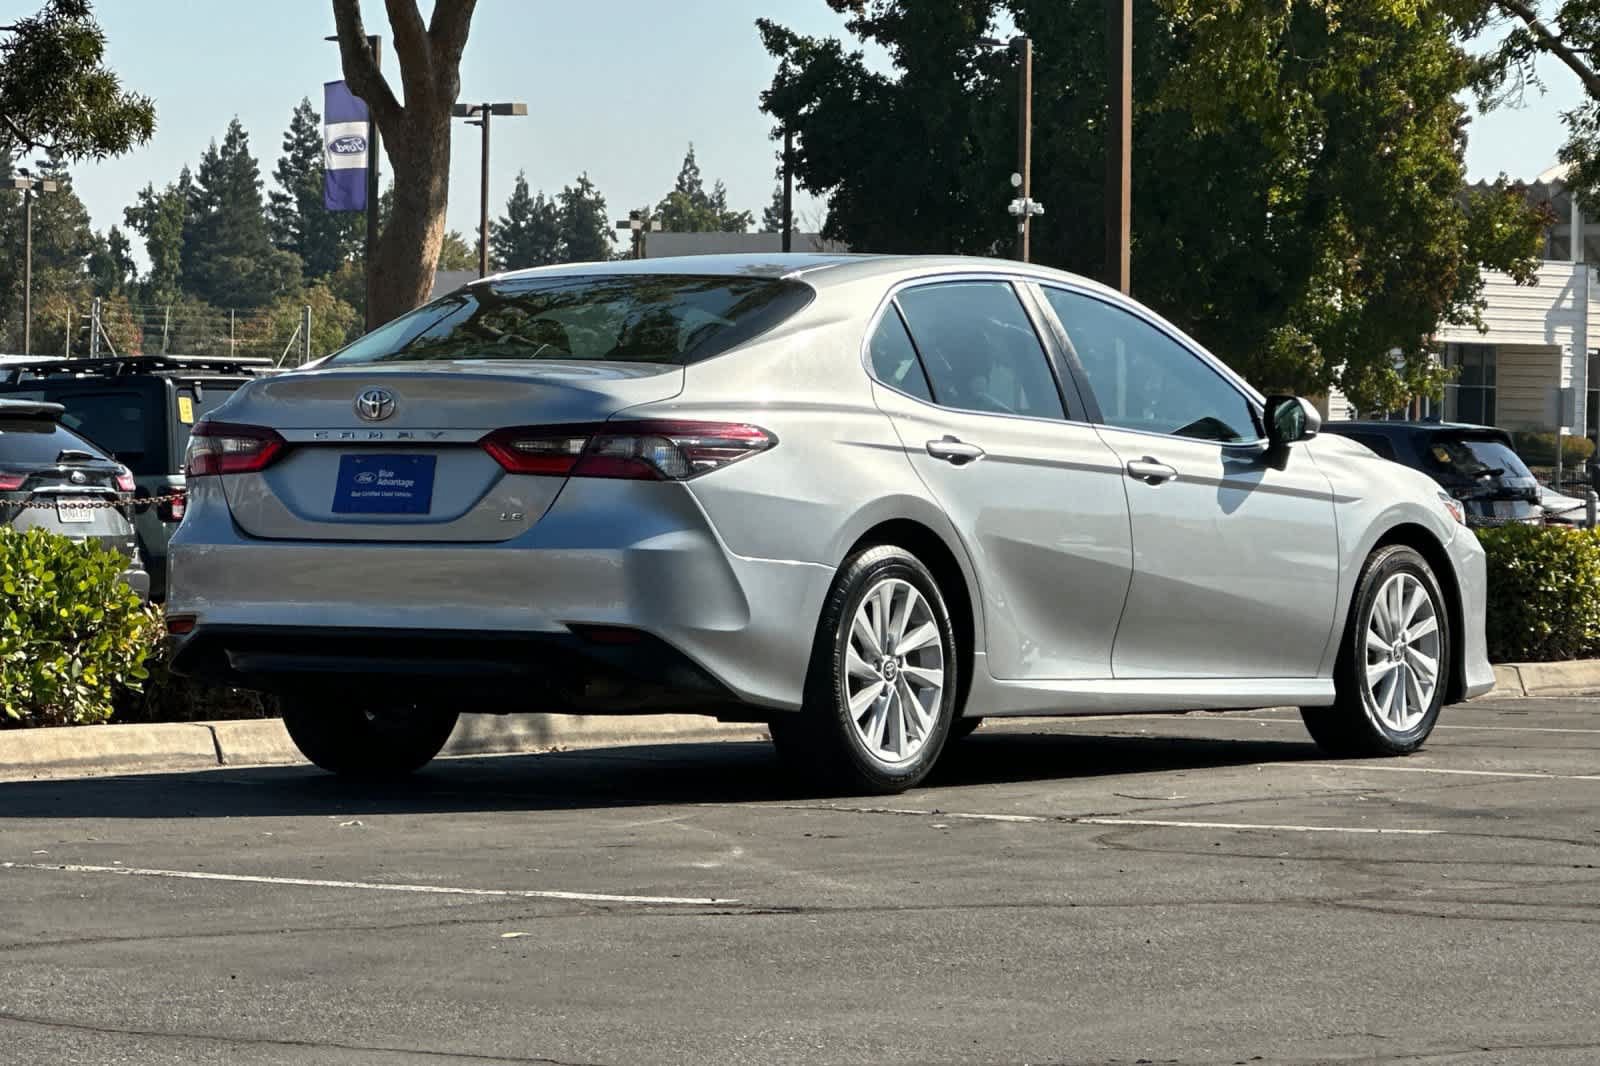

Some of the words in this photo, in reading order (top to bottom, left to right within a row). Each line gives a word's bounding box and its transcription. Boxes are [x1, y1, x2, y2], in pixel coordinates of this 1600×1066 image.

[313, 430, 448, 440] CAMRY
[378, 469, 394, 478] Blue
[376, 478, 415, 488] Advantage
[499, 512, 523, 521] LE
